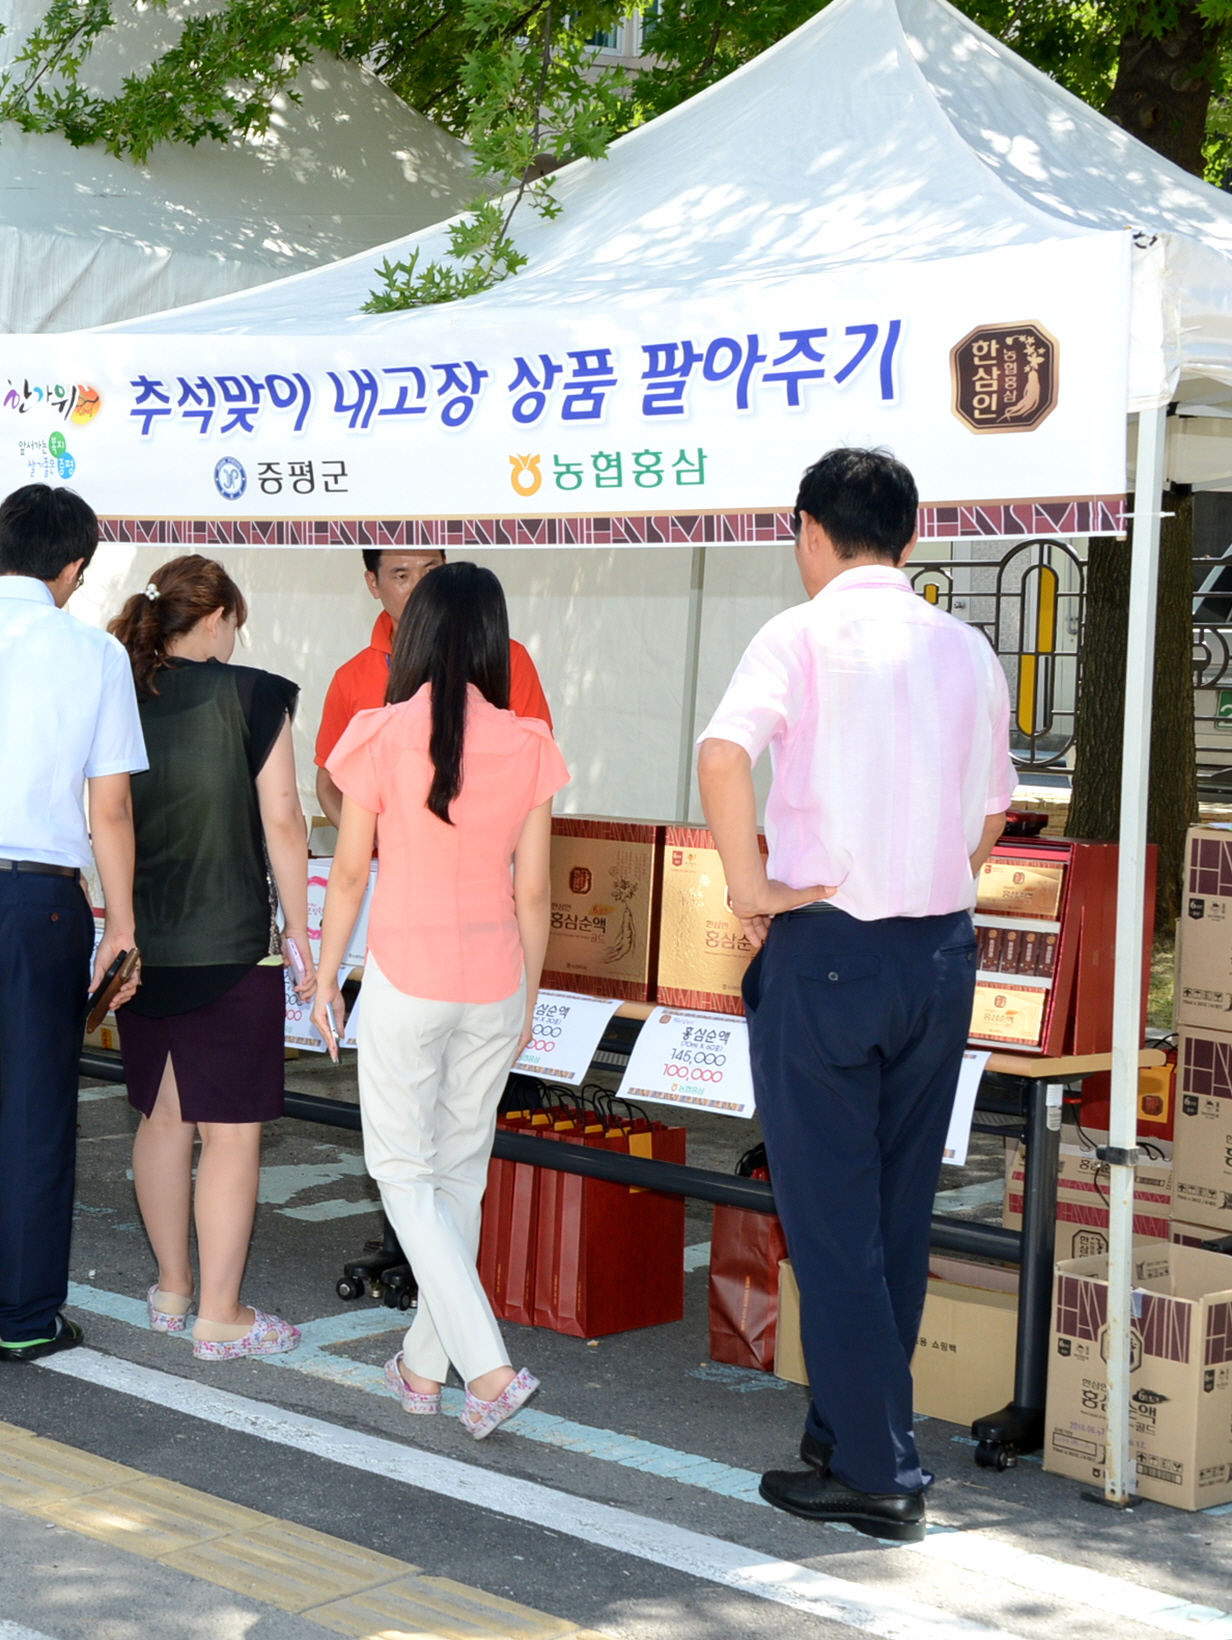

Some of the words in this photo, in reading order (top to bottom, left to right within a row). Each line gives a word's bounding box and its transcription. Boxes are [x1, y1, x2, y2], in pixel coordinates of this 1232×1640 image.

[129, 373, 311, 435] 추석맞이
[325, 361, 489, 429] 내고장
[508, 348, 618, 424] 상품
[640, 319, 902, 416] 팔아주기
[971, 339, 1001, 419] 한삼인
[1003, 349, 1018, 403] 농협홍삼
[3, 378, 77, 421] 한가위
[19, 440, 47, 456] 앞서가는
[51, 437, 65, 454] 복지
[28, 457, 55, 478] 살기좋은
[58, 459, 74, 476] 증평
[257, 460, 349, 495] 증평군
[552, 447, 708, 491] 농협홍삼
[550, 911, 607, 934] 홍삼순액
[705, 930, 765, 952] 홍삼순
[534, 1003, 571, 1019] 삼순액
[682, 1026, 731, 1045] 홍삼순액
[671, 1048, 727, 1067] 145,000
[663, 1063, 724, 1083] 100,000
[1135, 1421, 1156, 1436] 골드
